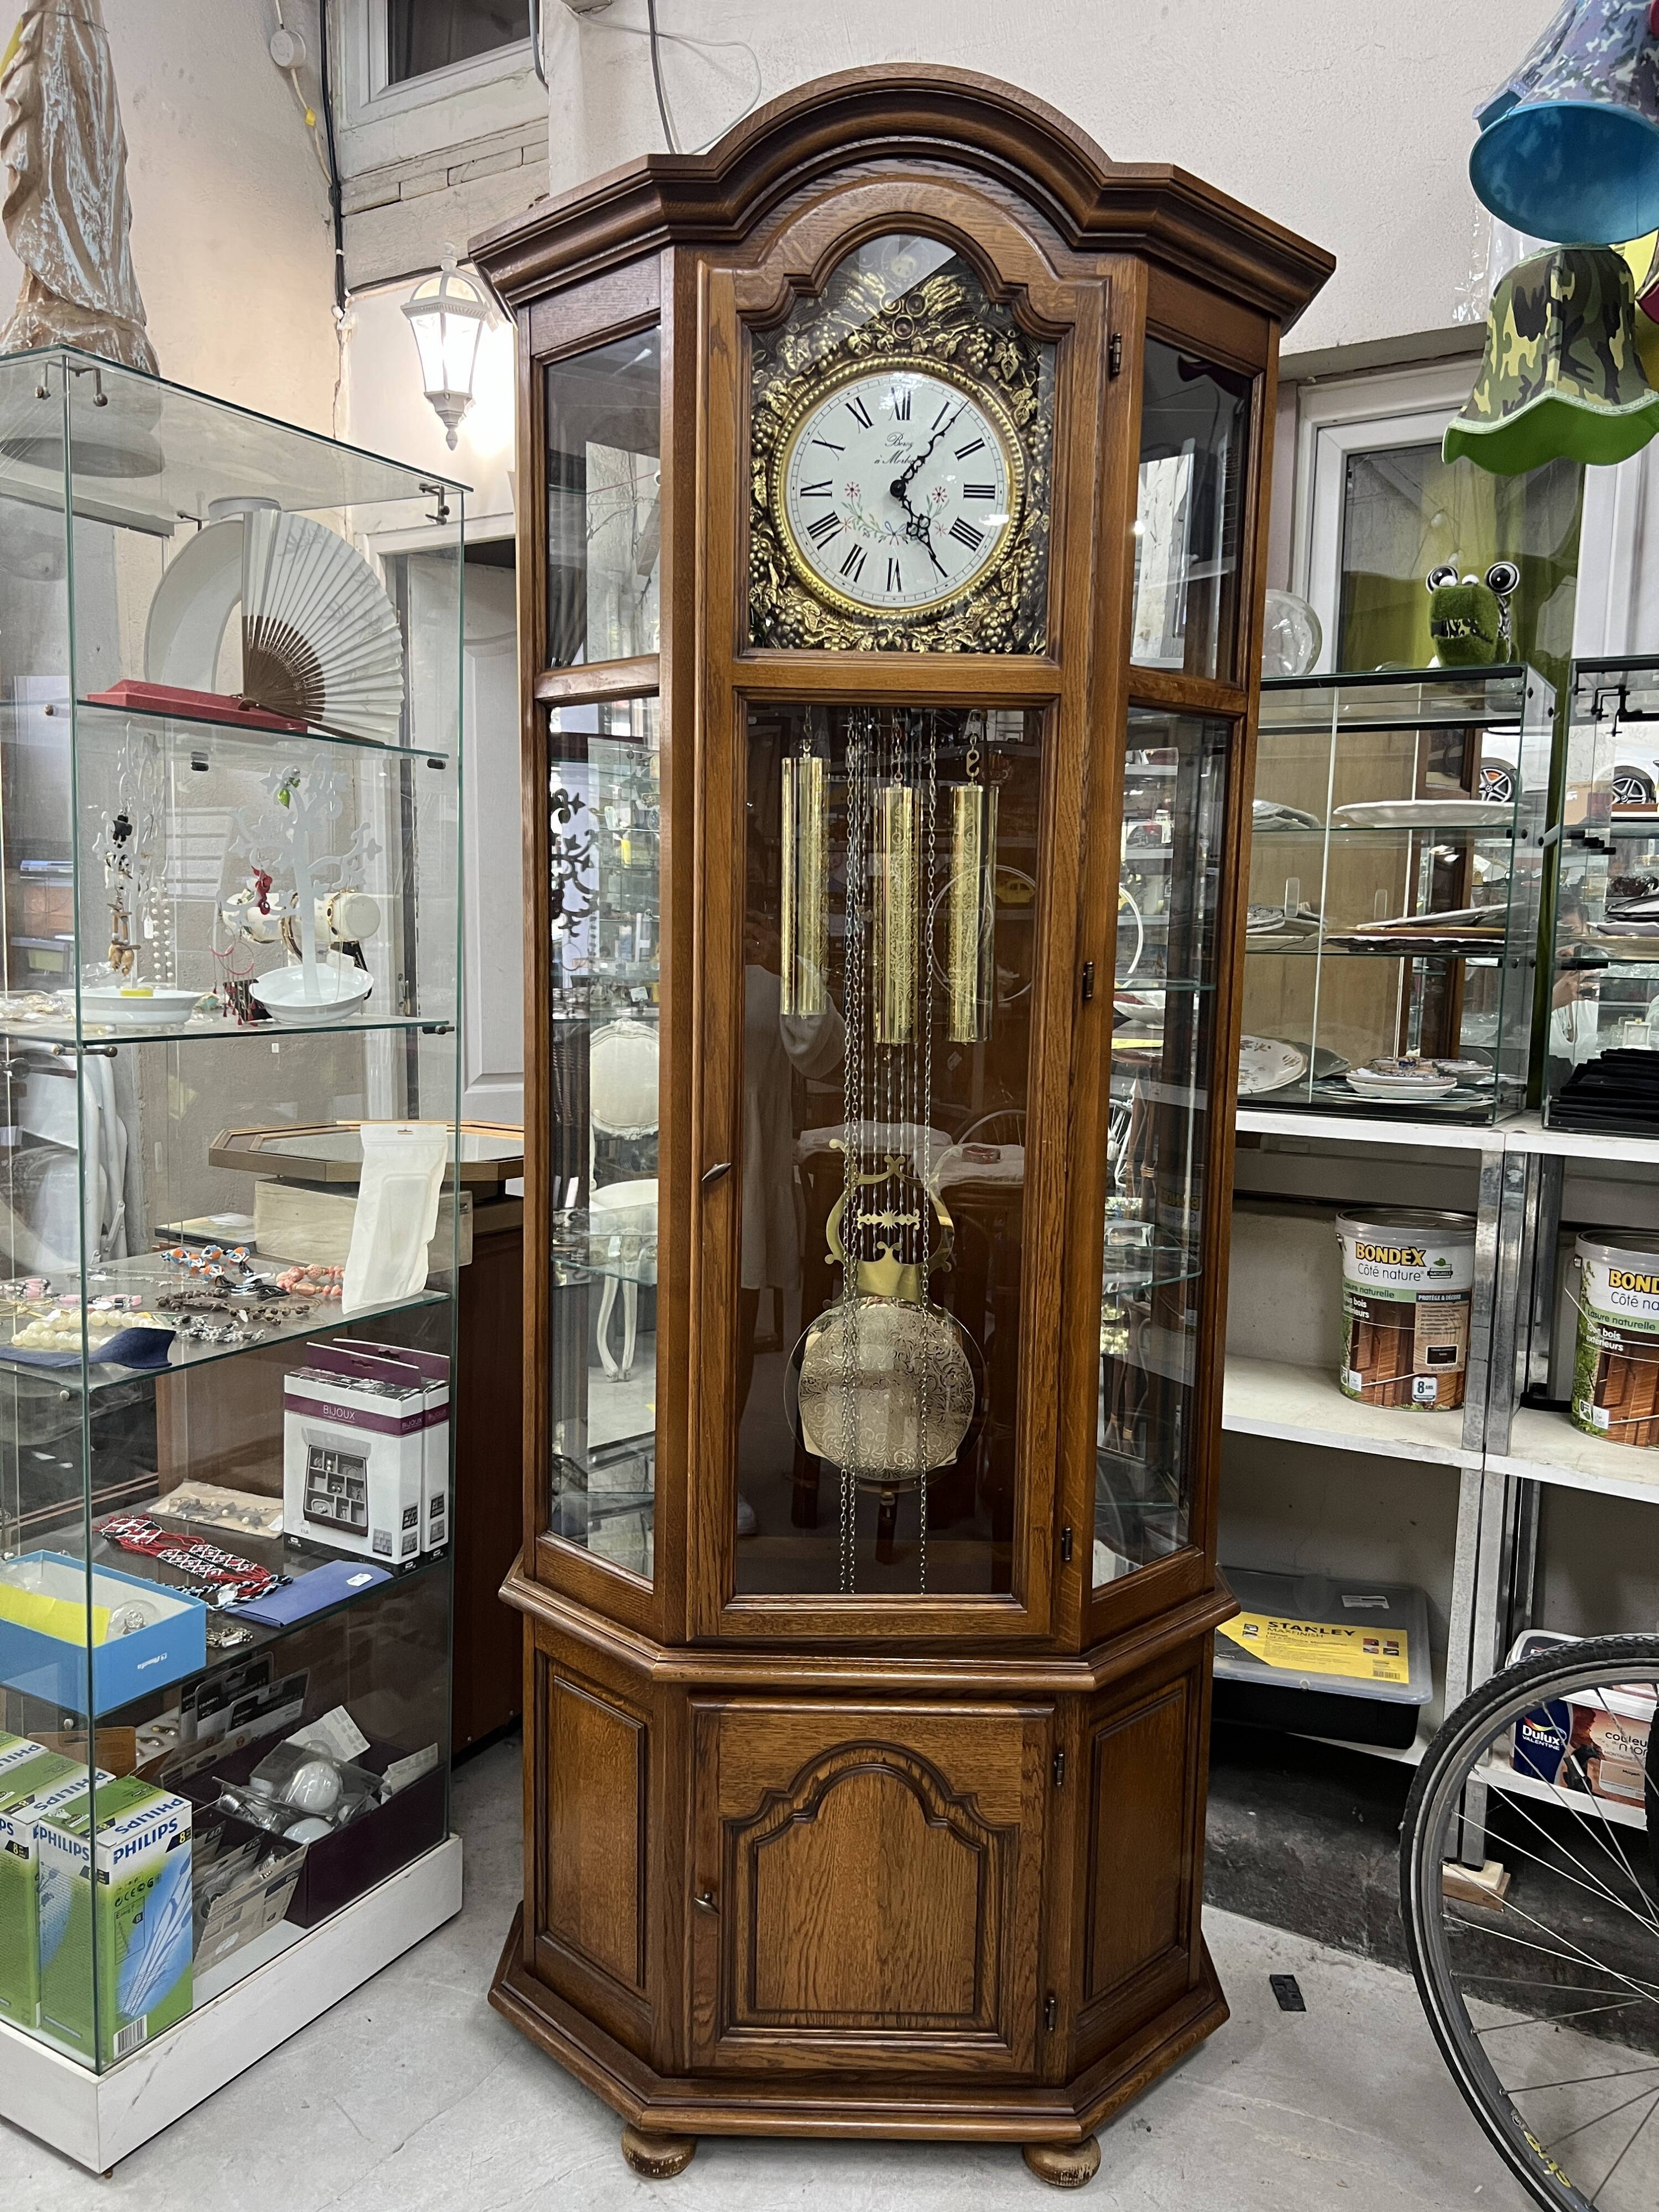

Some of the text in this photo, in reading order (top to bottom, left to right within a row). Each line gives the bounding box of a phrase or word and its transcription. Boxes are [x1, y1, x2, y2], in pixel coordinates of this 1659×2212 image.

[1355, 1241, 1427, 1267] BONDEX
[1358, 1263, 1421, 1281] Côté nature
[1360, 1287, 1395, 1298] naturelle
[1611, 1291, 1638, 1307] Côté
[1353, 1297, 1367, 1308] bois
[1588, 1308, 1656, 1331] Lasure naturelle
[1602, 1327, 1621, 1340] bois
[1417, 1381, 1425, 1394] 8
[323, 1405, 356, 1420] BIJOUX
[401, 1417, 422, 1429] BIJOUX
[1268, 1621, 1356, 1636] STANLEY
[1522, 1725, 1560, 1745] Dulux
[1522, 1735, 1560, 1751] VALENTINE
[33, 1771, 108, 1811] PHILIPS
[114, 1798, 185, 1834] PHILIPS
[40, 1825, 90, 1861] PHILIPS
[113, 1817, 178, 1865] PHILIPS
[179, 1831, 186, 1844] 8
